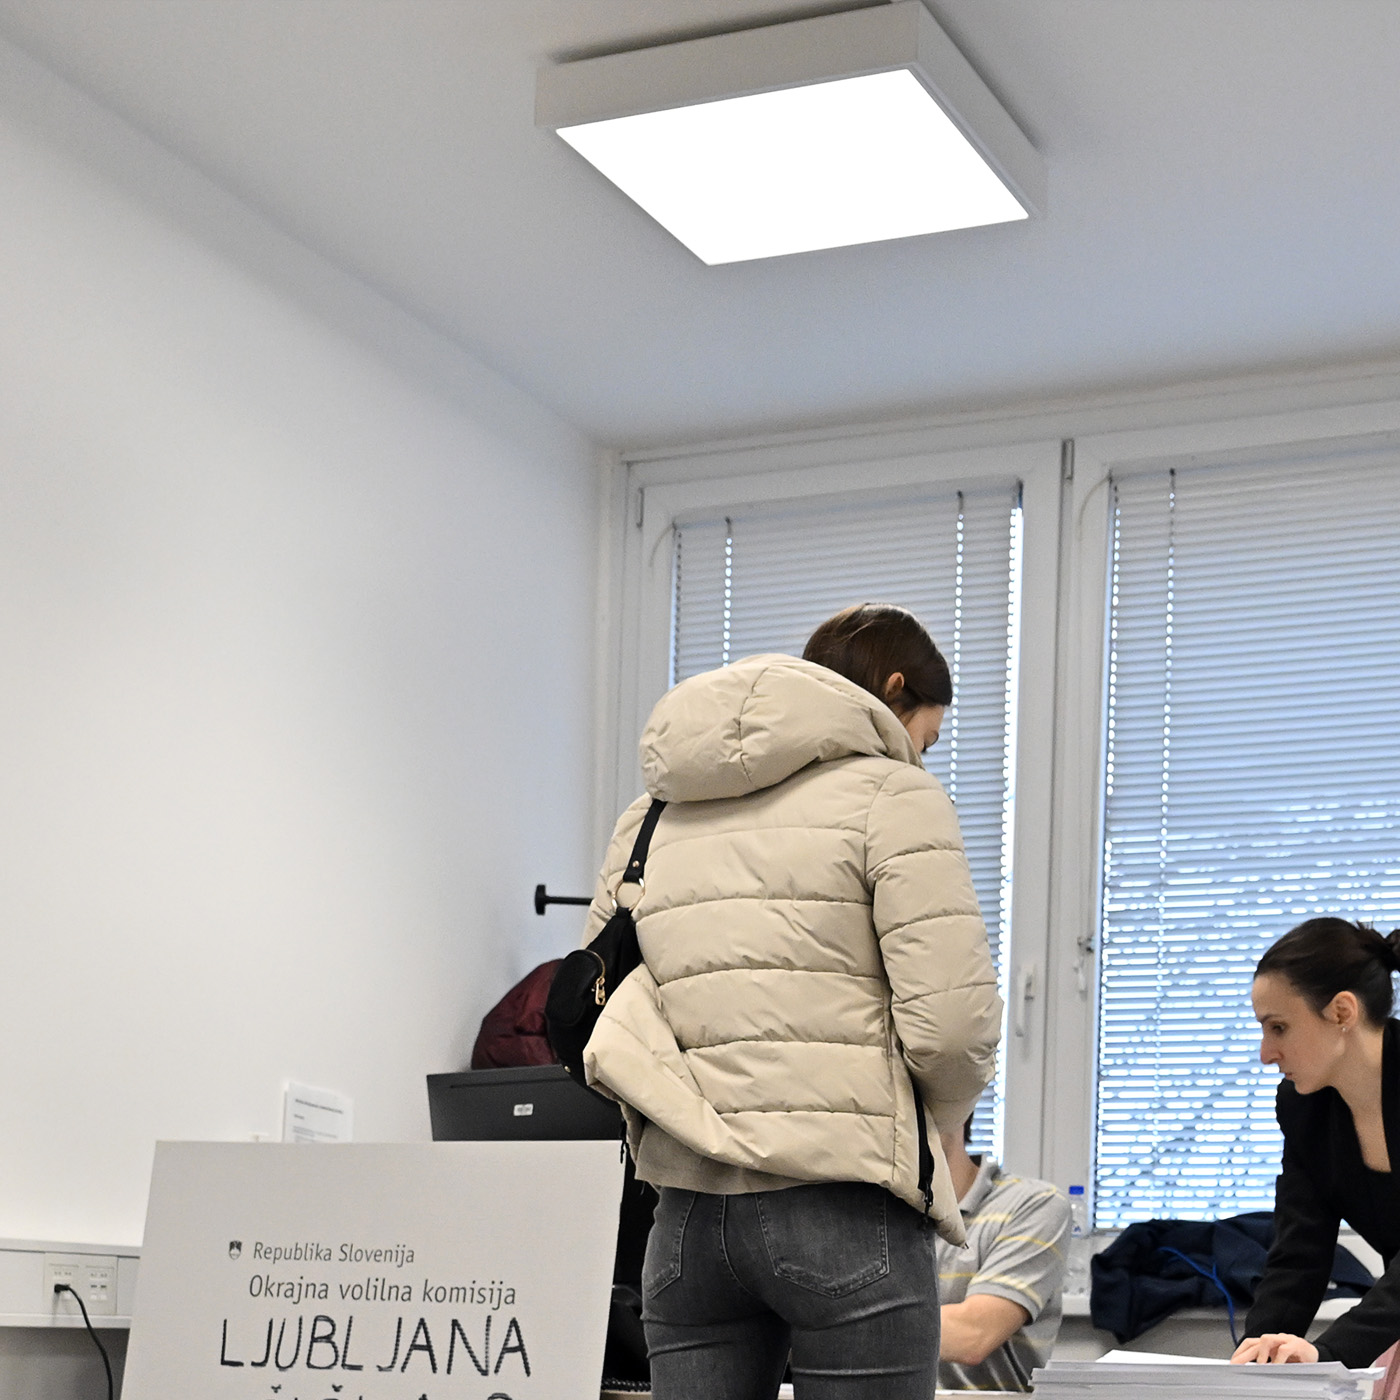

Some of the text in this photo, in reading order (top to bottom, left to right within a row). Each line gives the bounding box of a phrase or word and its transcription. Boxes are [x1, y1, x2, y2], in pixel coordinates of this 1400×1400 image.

[253, 1241, 415, 1269] Republika Slovenija
[249, 1274, 516, 1311] Okrajna volilna komisija
